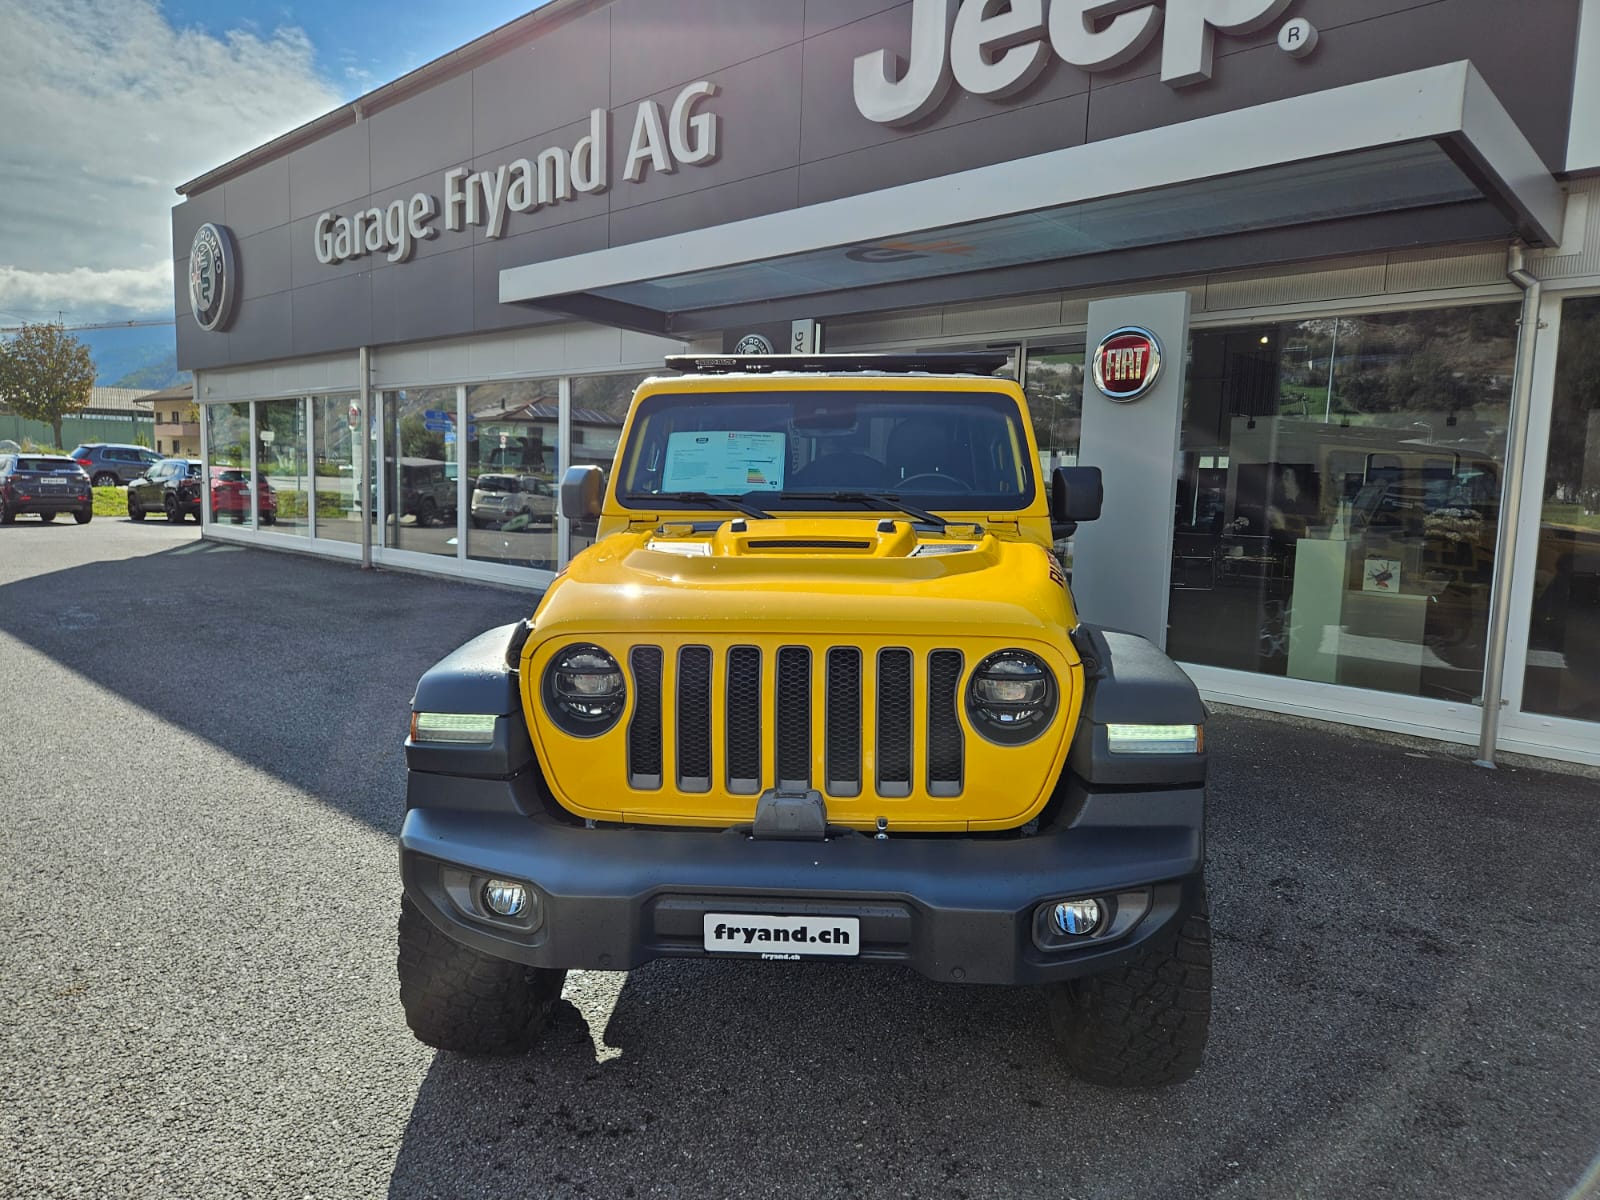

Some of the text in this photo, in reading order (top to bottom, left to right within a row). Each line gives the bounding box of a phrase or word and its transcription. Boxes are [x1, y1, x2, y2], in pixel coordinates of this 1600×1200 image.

[314, 80, 719, 264] Garage Fryand AG
[794, 331, 804, 353] AG
[1105, 347, 1147, 381] FIAT
[714, 923, 850, 945] fryand.ch
[761, 953, 801, 961] fryand.ch
